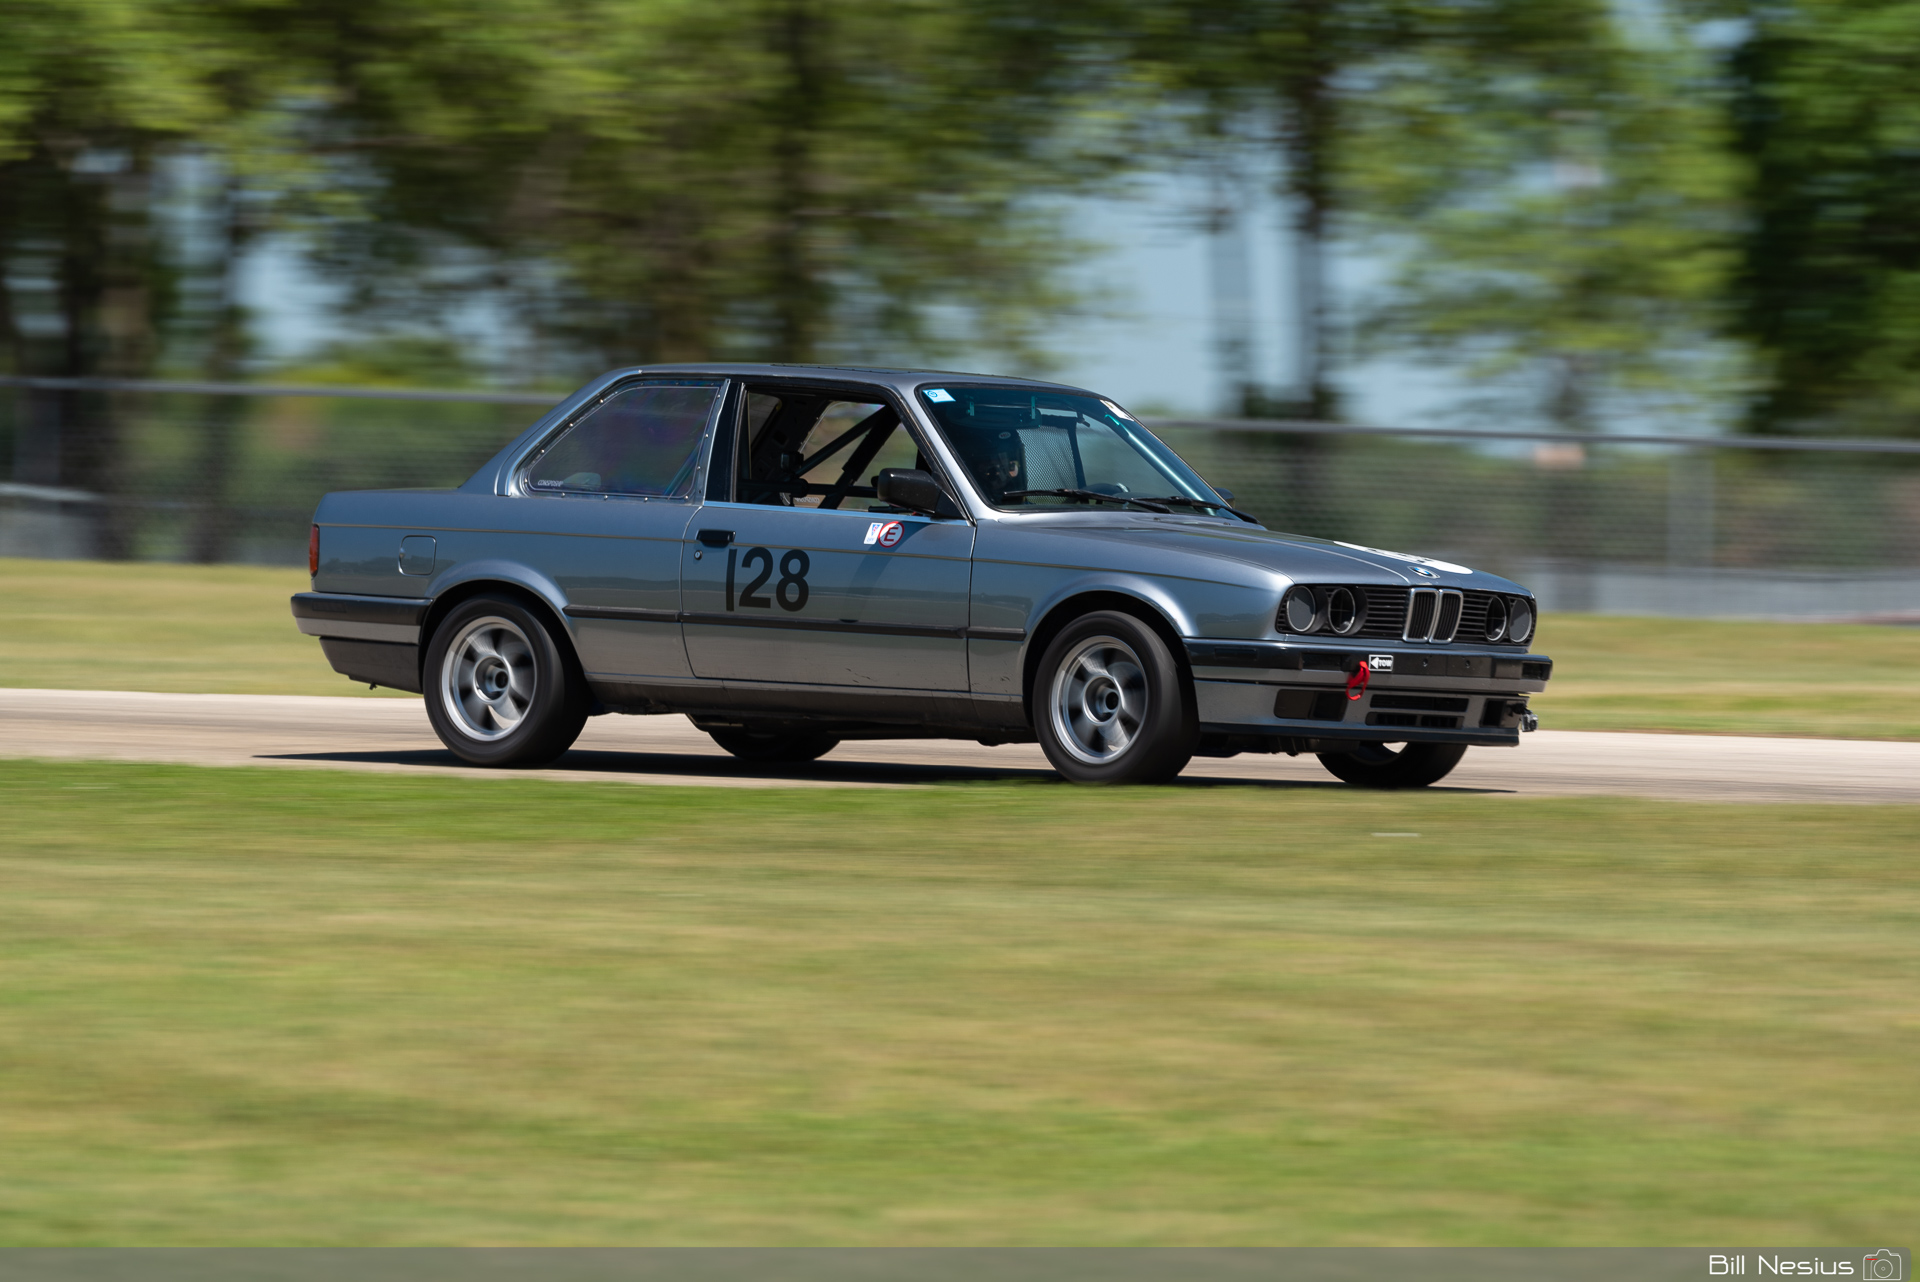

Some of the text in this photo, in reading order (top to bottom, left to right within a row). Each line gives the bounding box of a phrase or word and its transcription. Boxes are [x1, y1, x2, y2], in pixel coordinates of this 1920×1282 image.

[884, 527, 899, 541] E
[726, 547, 809, 612] 128
[1378, 659, 1393, 667] TOW
